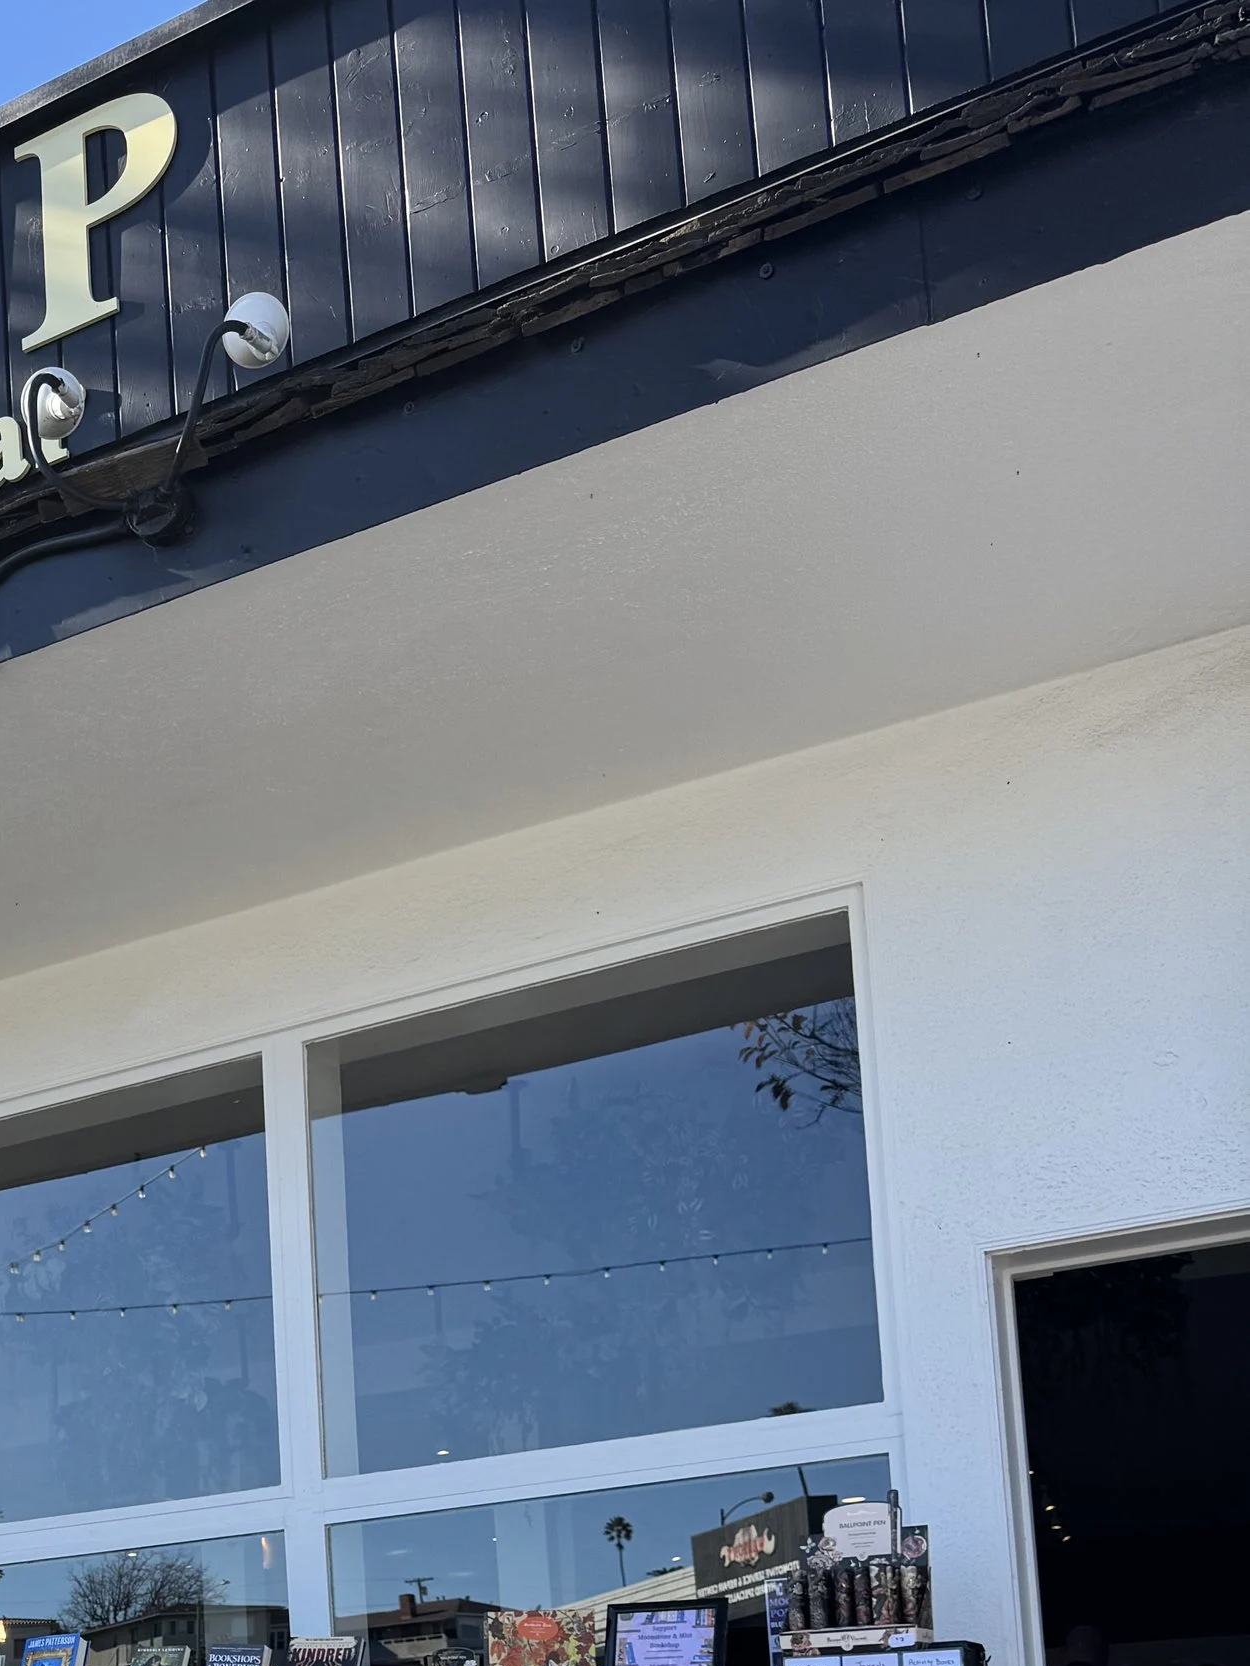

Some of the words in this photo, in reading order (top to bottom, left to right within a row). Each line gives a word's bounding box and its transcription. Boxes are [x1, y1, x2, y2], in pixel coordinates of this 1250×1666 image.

[839, 1521, 871, 1529] BALLPOINT
[28, 1640, 44, 1648] JAMES
[45, 1636, 75, 1646] PATTERSON
[209, 1654, 261, 1664] BOOKSHOPS
